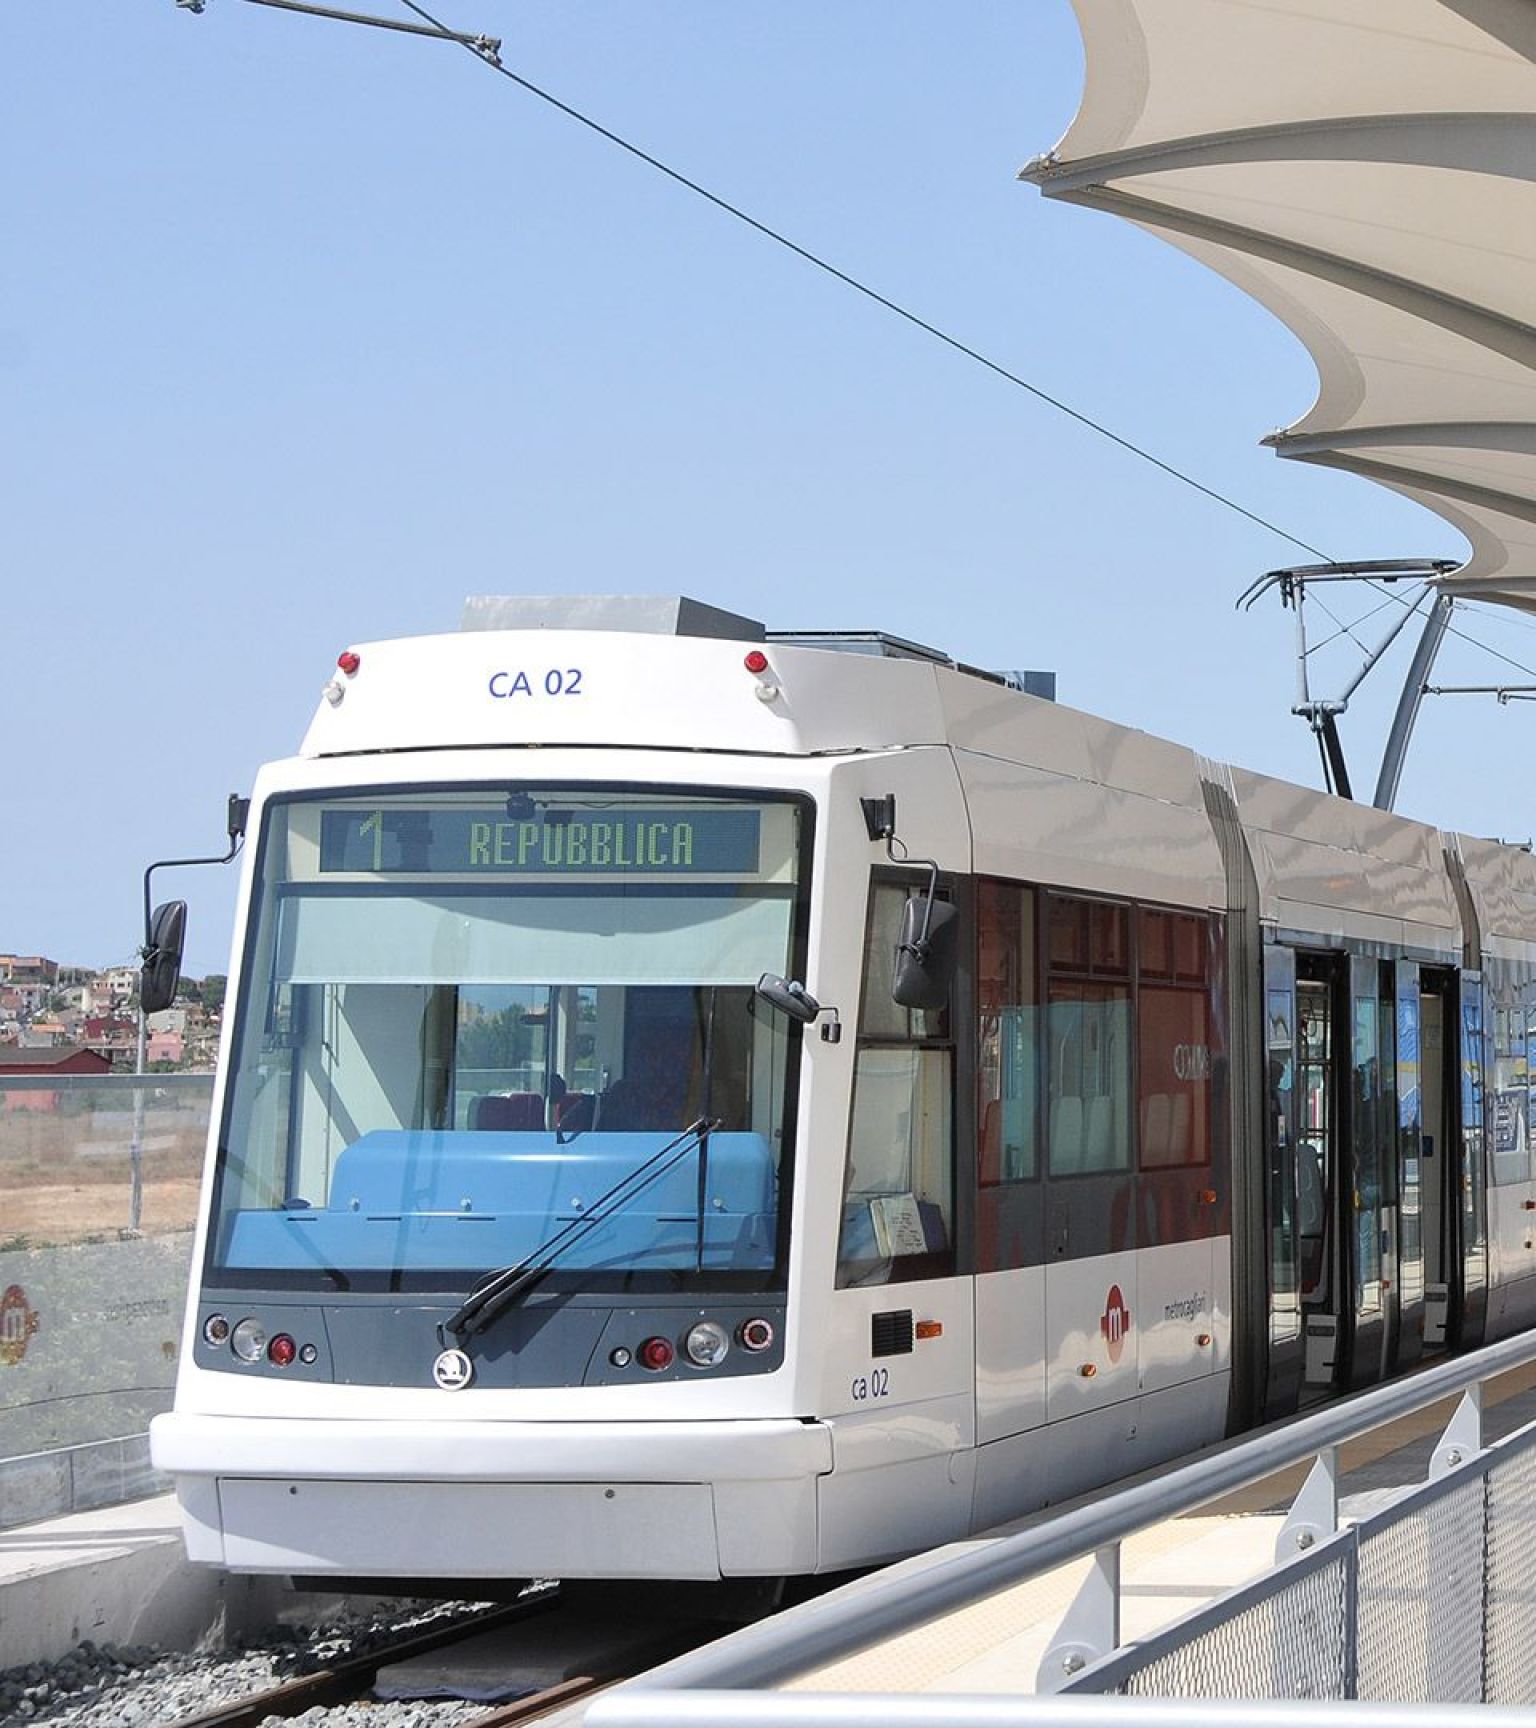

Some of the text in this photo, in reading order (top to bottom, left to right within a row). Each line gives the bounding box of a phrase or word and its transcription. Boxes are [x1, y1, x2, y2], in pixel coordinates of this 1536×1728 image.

[488, 668, 582, 699] CA 02
[359, 809, 693, 871] 1 REPUBBLICA
[852, 1367, 889, 1401] ca 02
